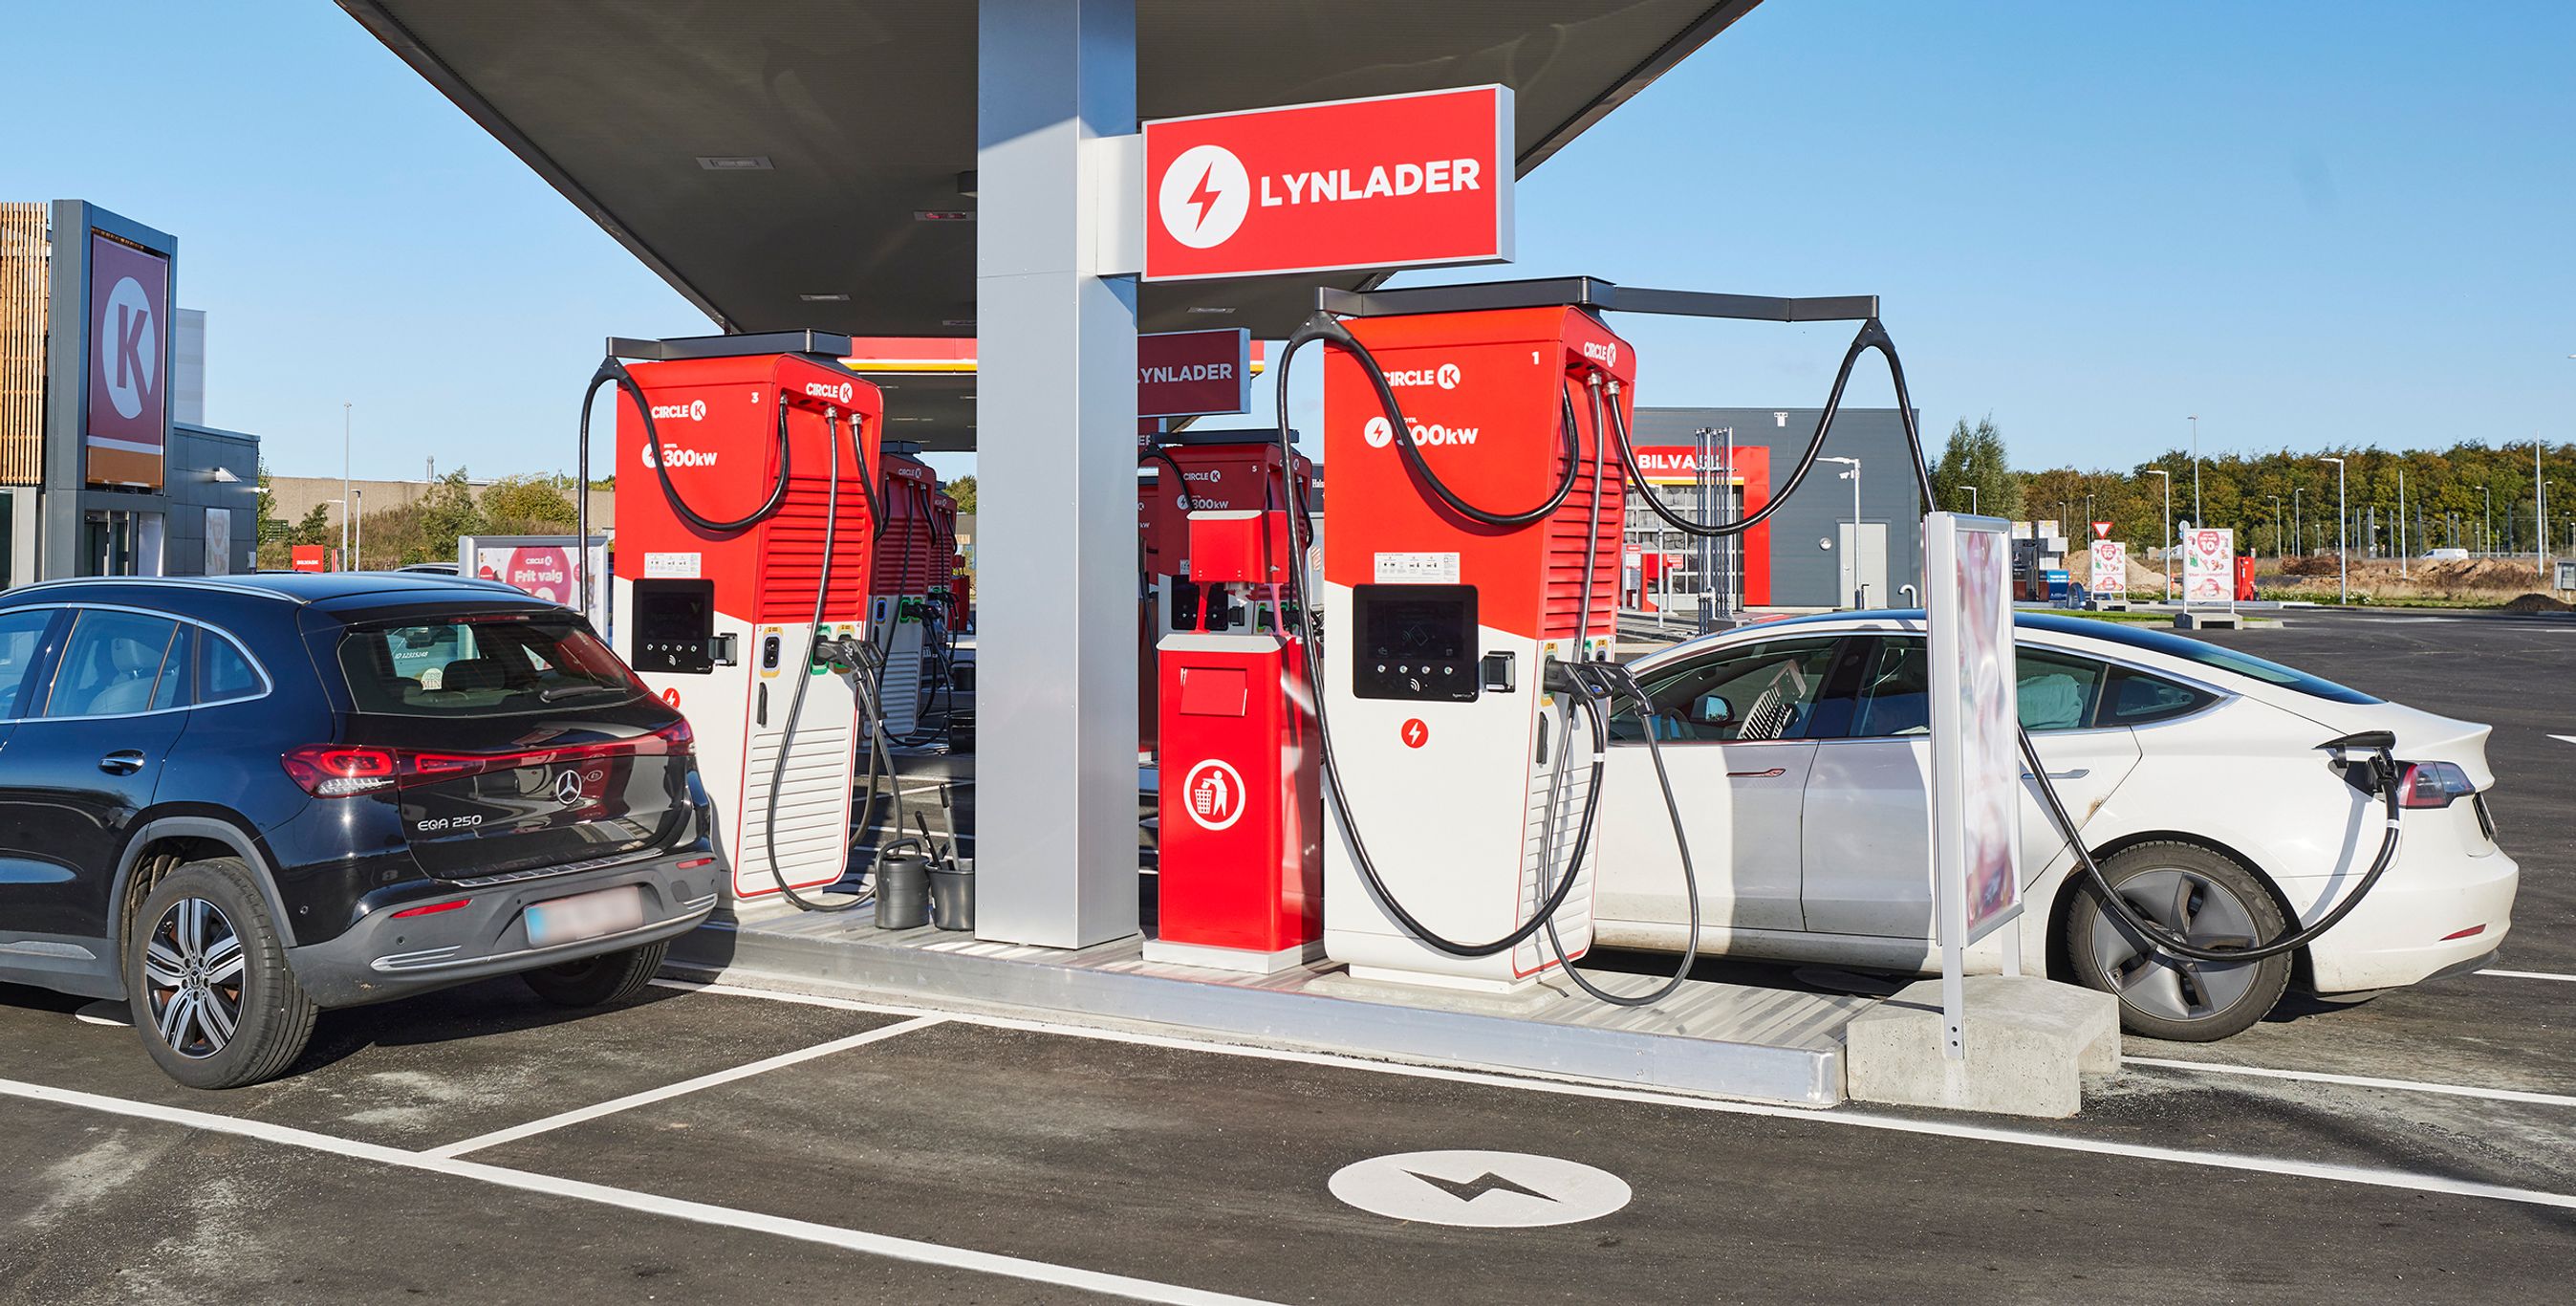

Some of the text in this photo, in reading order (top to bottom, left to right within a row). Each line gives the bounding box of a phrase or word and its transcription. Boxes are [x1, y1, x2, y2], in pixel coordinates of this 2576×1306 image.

[1261, 158, 1481, 207] LYNLADER
[106, 283, 153, 414] K
[1584, 341, 1616, 367] CIRCLE K
[1531, 351, 1540, 365] 1
[1137, 363, 1233, 383] YNLADER
[1438, 364, 1460, 388] K
[750, 392, 759, 403] 3
[806, 382, 853, 403] CIRCLE K
[651, 401, 705, 421] CIRCLE K
[662, 448, 718, 467] 300kW
[898, 468, 915, 477] CIRCLE
[1182, 469, 1221, 482] CIRCLE K
[1191, 498, 1229, 510] 300kW
[525, 556, 545, 565] CIRCLE
[514, 570, 536, 582] Frit
[537, 569, 563, 583] valg
[417, 815, 483, 831] EQA 250
